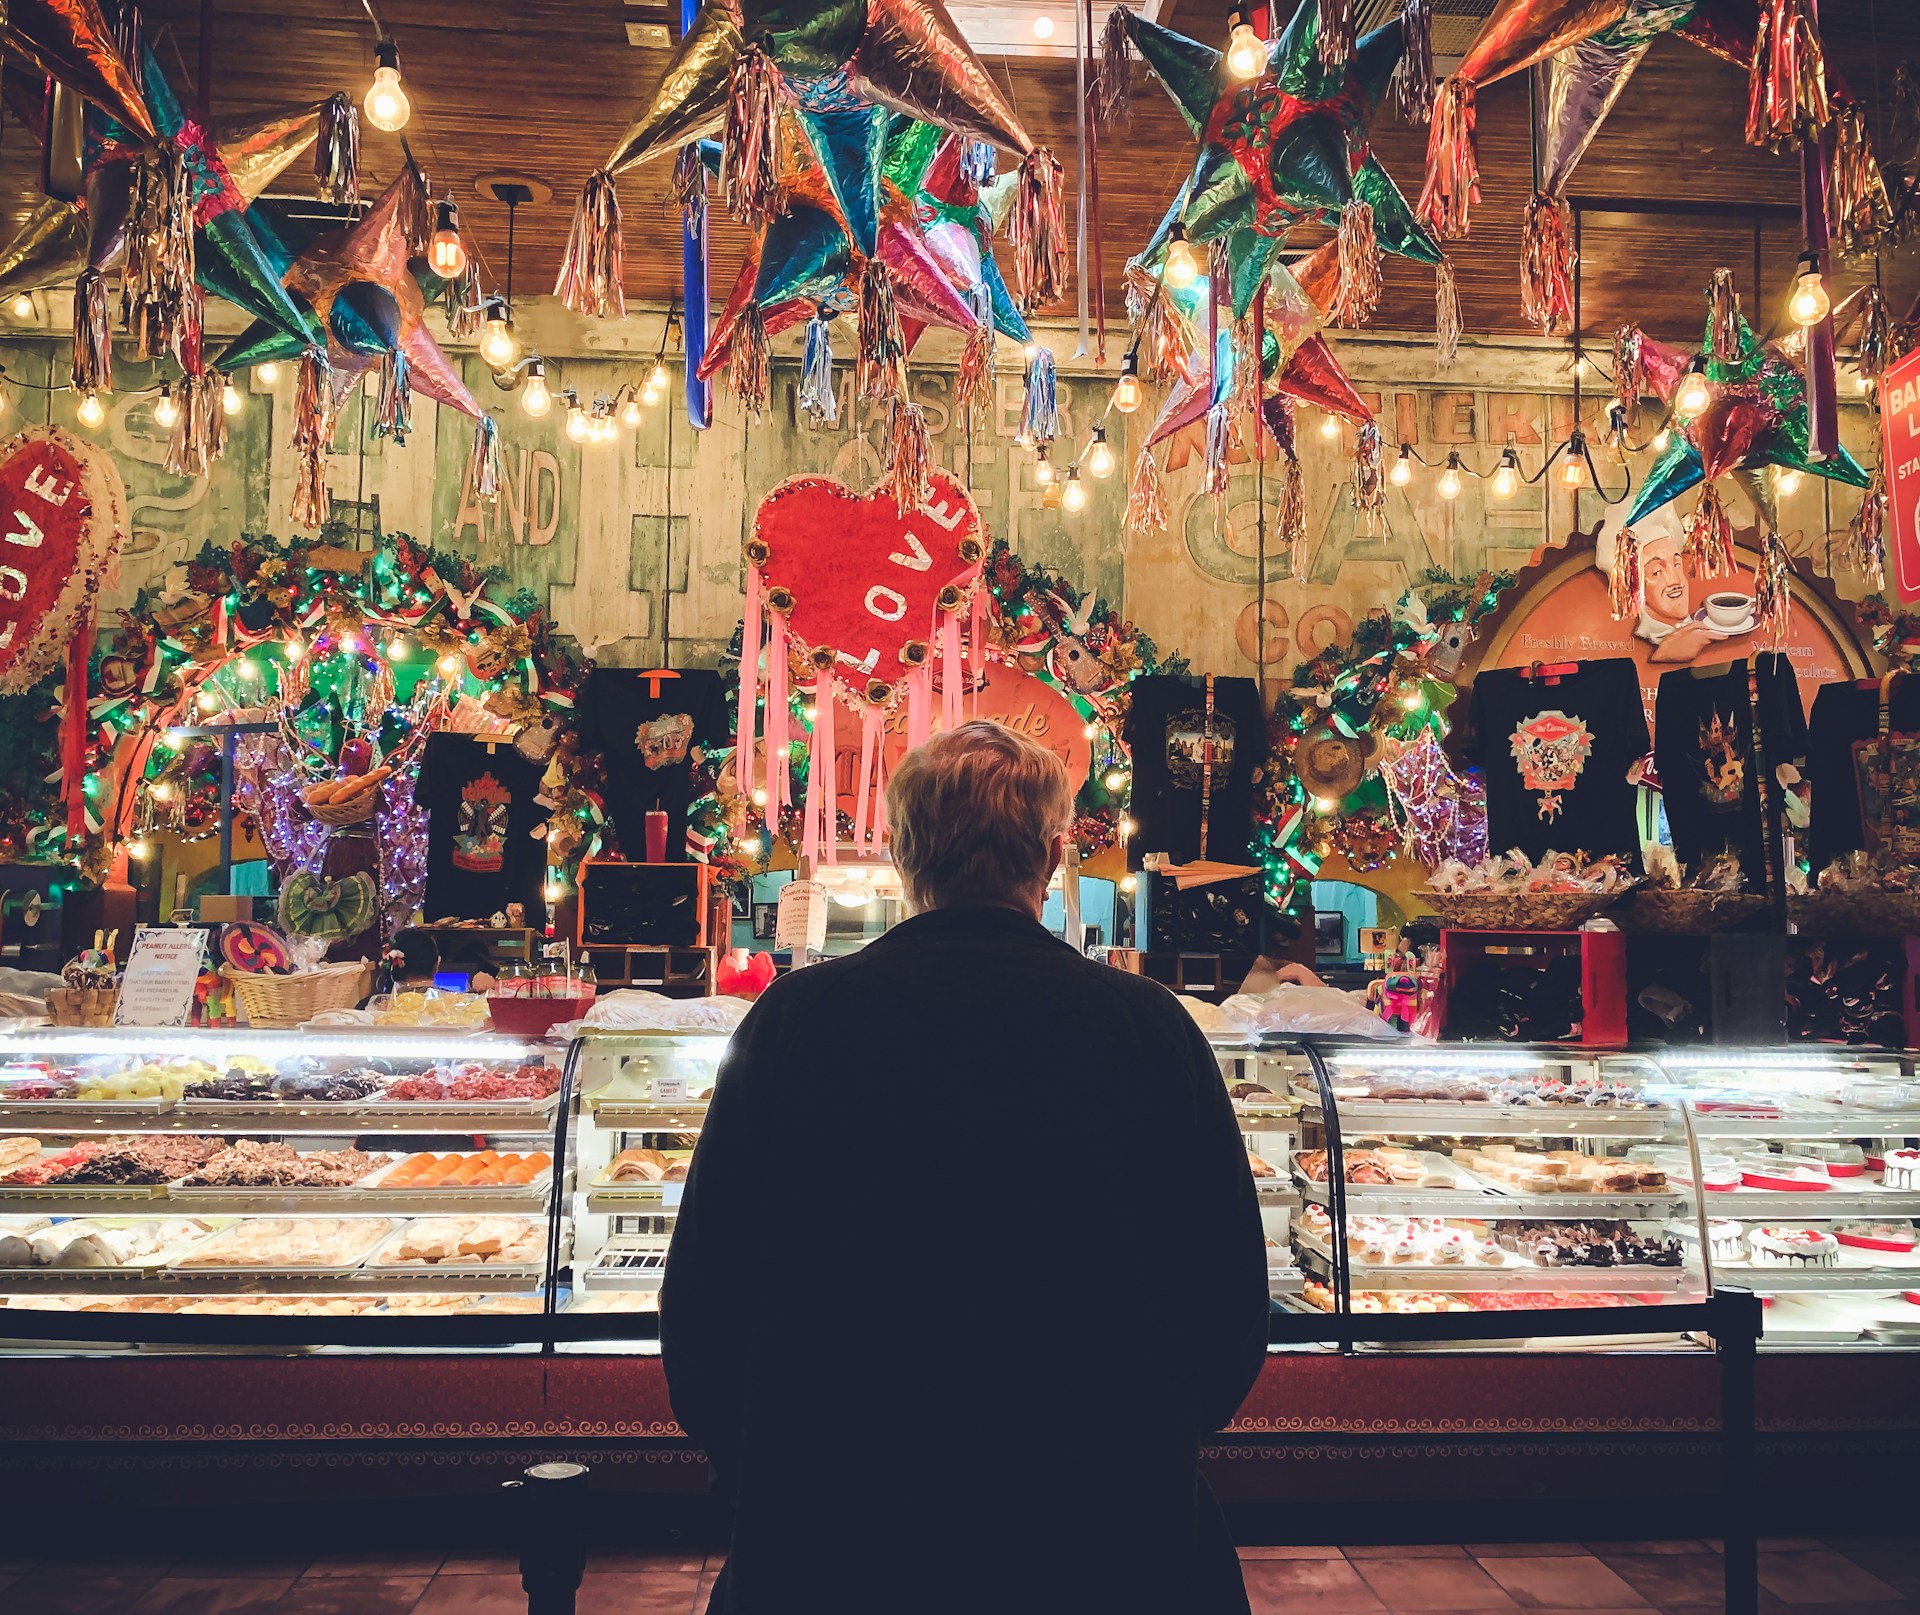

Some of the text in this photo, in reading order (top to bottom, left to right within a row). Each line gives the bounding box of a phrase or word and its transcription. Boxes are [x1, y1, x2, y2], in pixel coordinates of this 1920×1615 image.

[1890, 373, 1920, 417] BA
[836, 485, 967, 676] LOVE
[1521, 633, 1635, 652] Freshly Brewed
